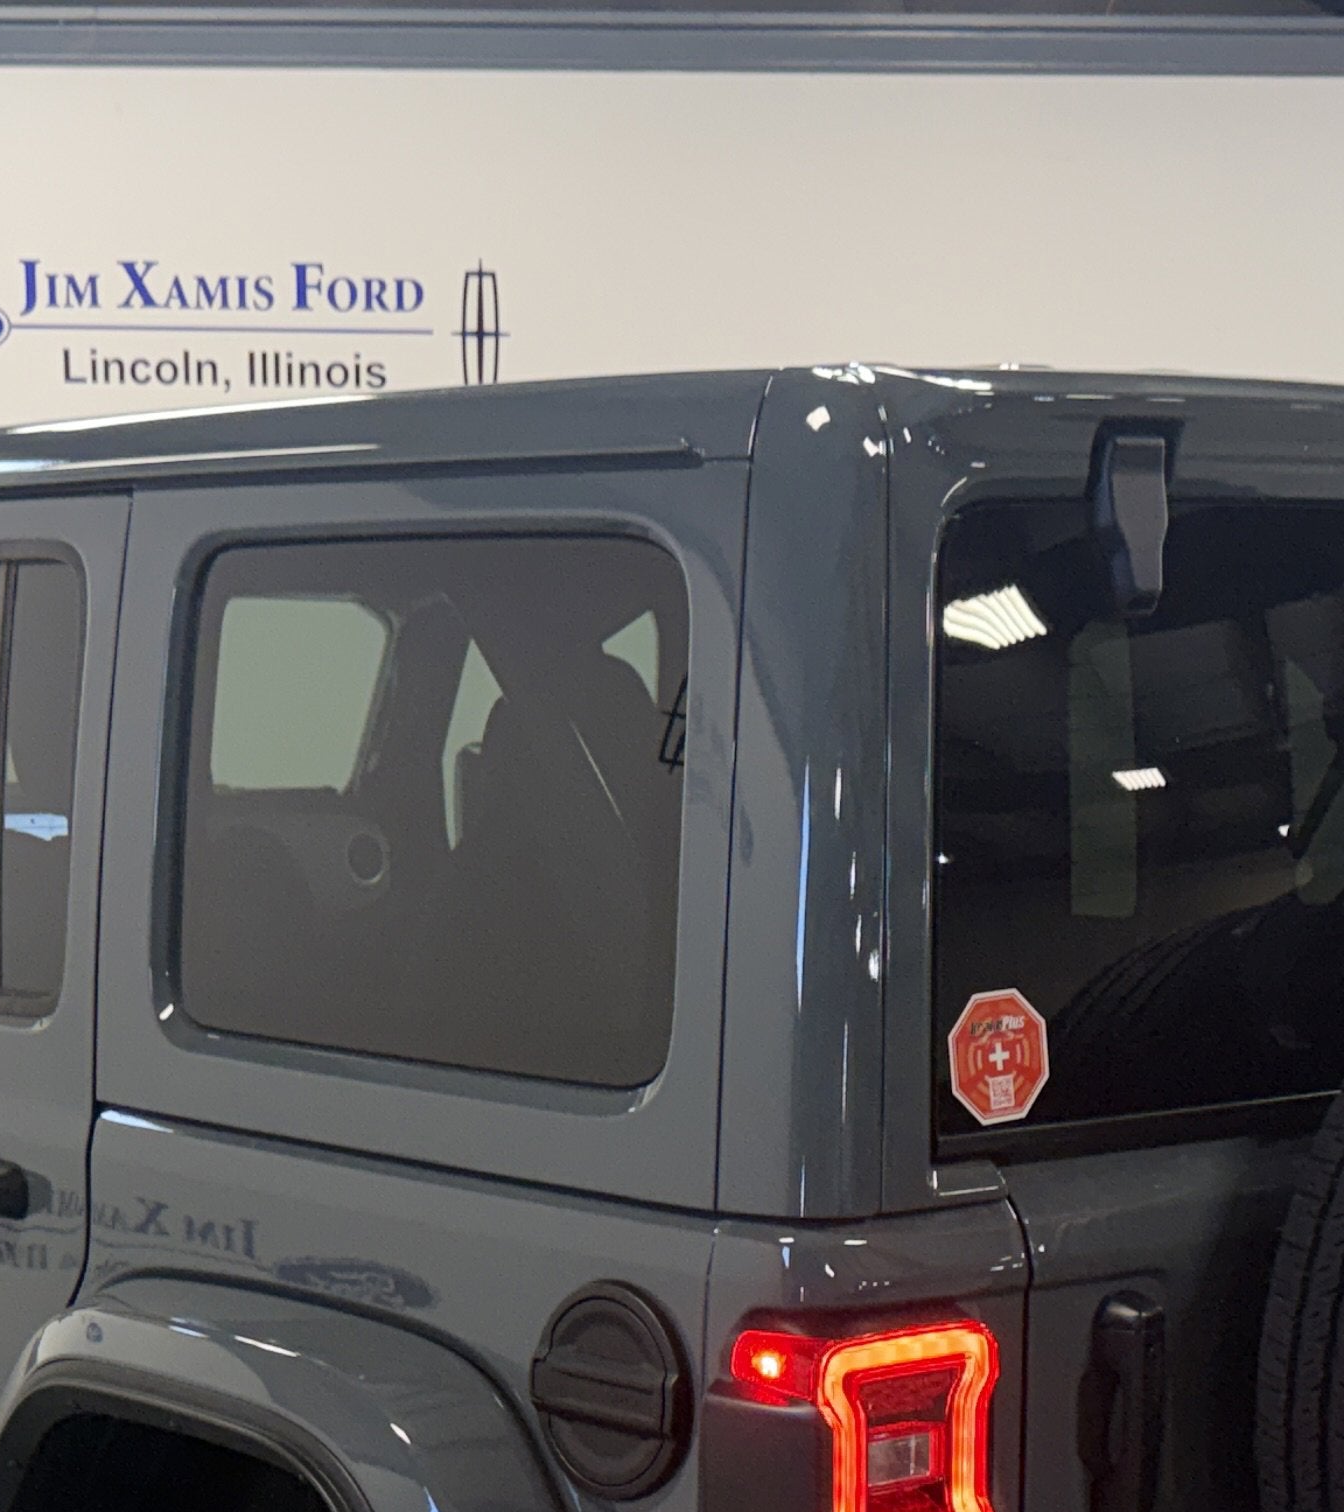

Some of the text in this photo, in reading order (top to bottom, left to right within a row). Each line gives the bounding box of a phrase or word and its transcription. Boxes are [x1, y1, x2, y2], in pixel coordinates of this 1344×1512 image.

[19, 259, 425, 316] JIM XAMIS FORD
[62, 348, 388, 393] Lincoln, Illinois
